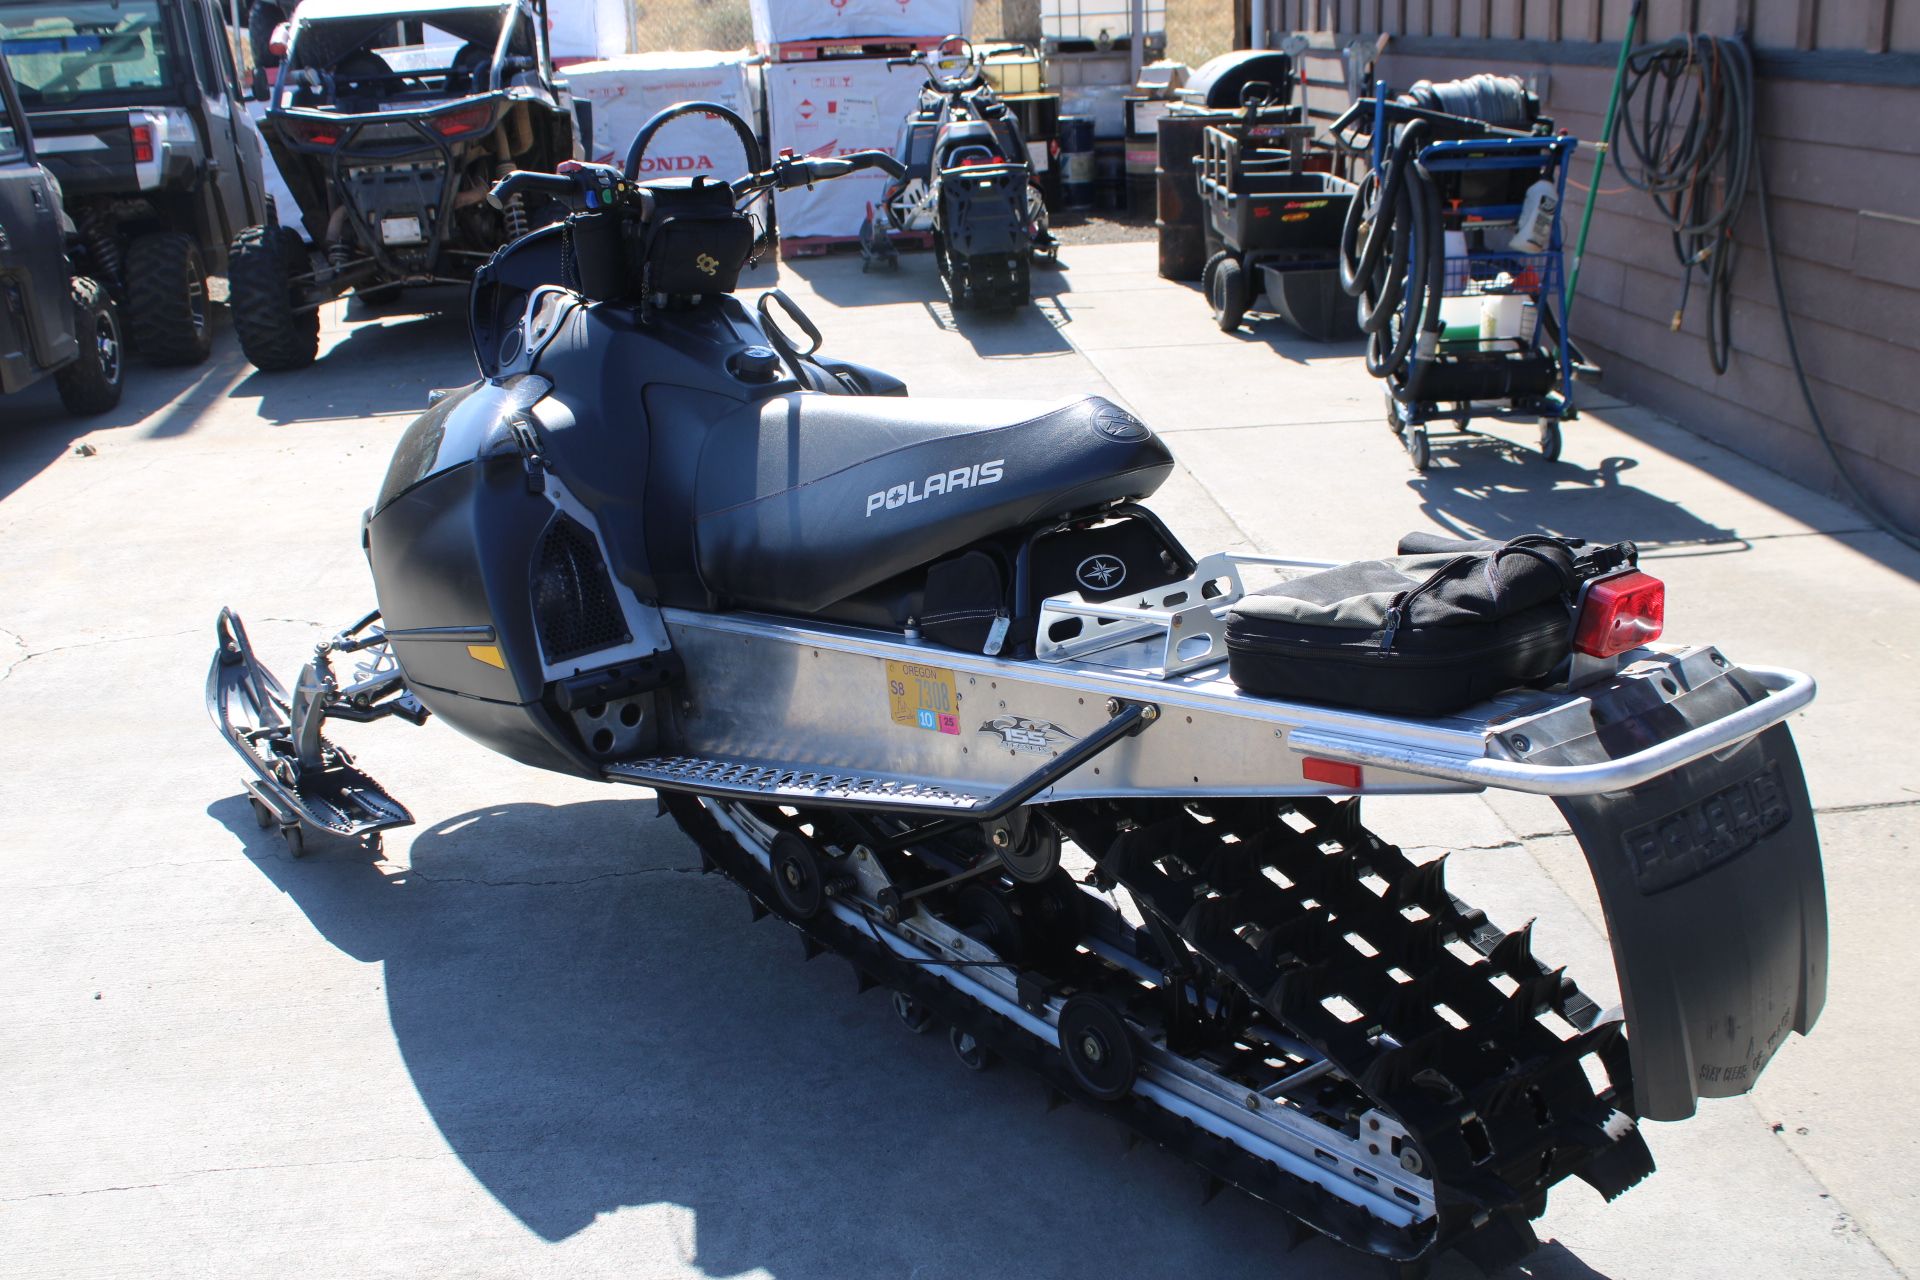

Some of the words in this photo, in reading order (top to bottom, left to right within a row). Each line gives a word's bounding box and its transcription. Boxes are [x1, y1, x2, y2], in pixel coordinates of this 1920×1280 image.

[865, 459, 1005, 518] POLARIS
[902, 664, 937, 680] OREGON
[890, 679, 905, 696] S8
[919, 712, 933, 728] 10
[943, 716, 955, 727] 25
[1001, 728, 1047, 747] 155
[1628, 776, 1780, 875] POLARIS
